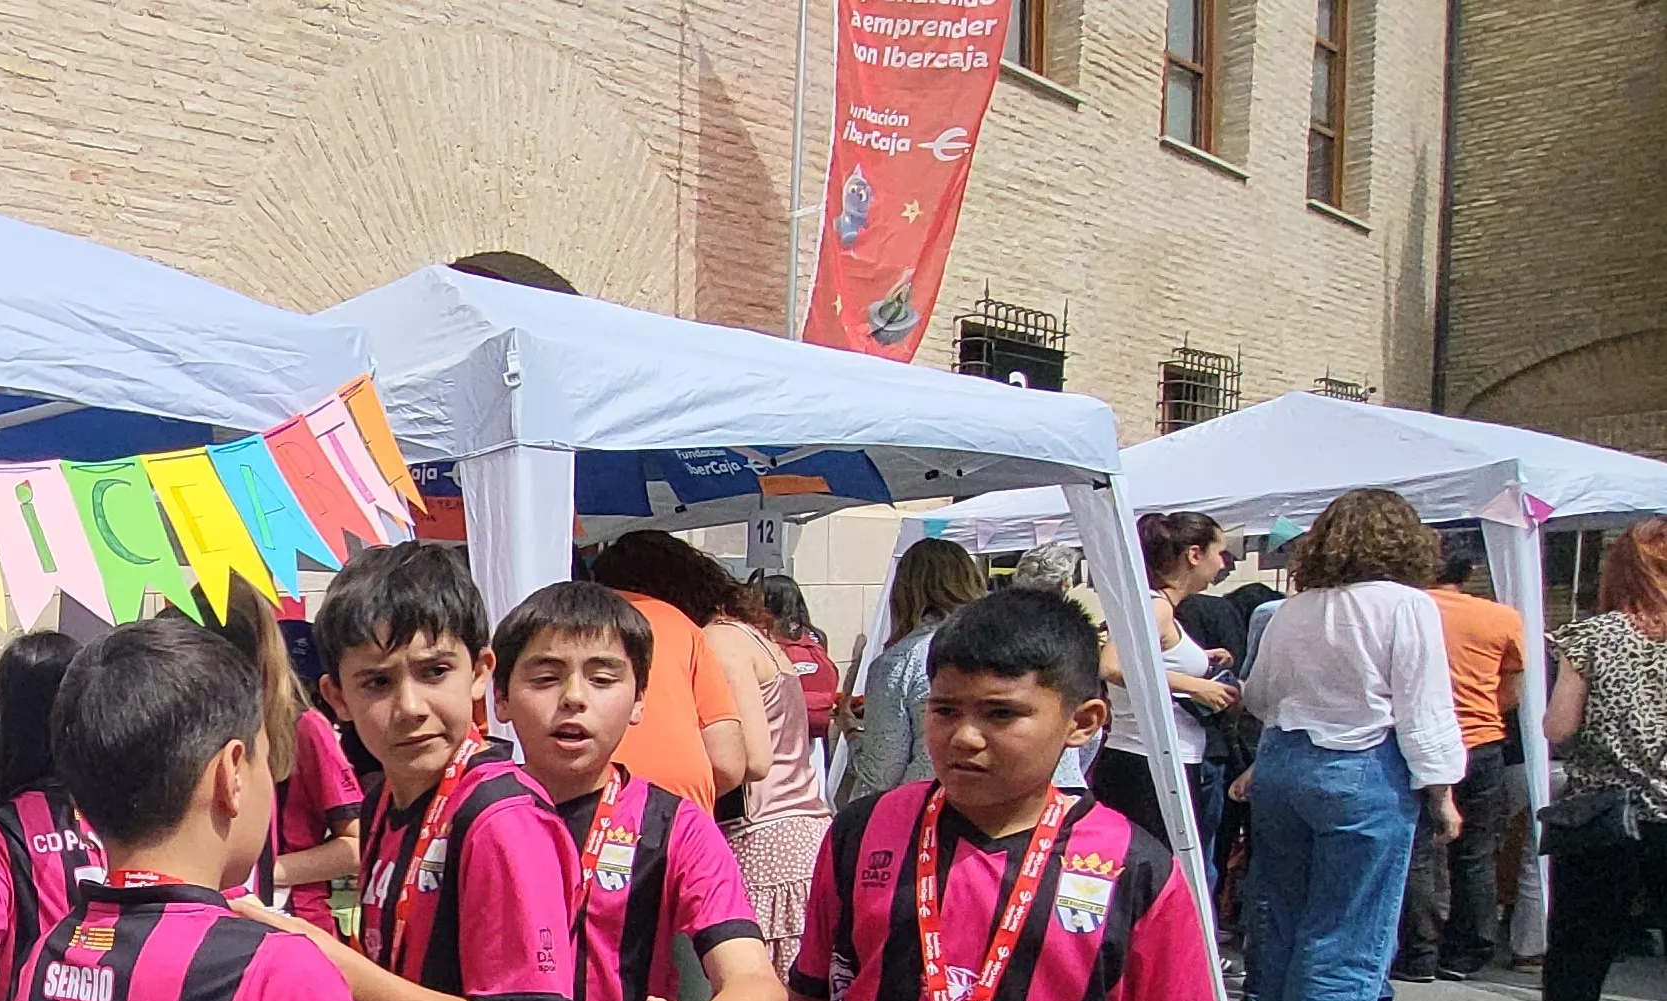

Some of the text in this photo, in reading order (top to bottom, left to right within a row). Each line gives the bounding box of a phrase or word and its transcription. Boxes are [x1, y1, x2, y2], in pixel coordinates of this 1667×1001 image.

[863, 14, 999, 40] emprender
[882, 44, 989, 73] Ibercaja
[757, 519, 774, 544] 12
